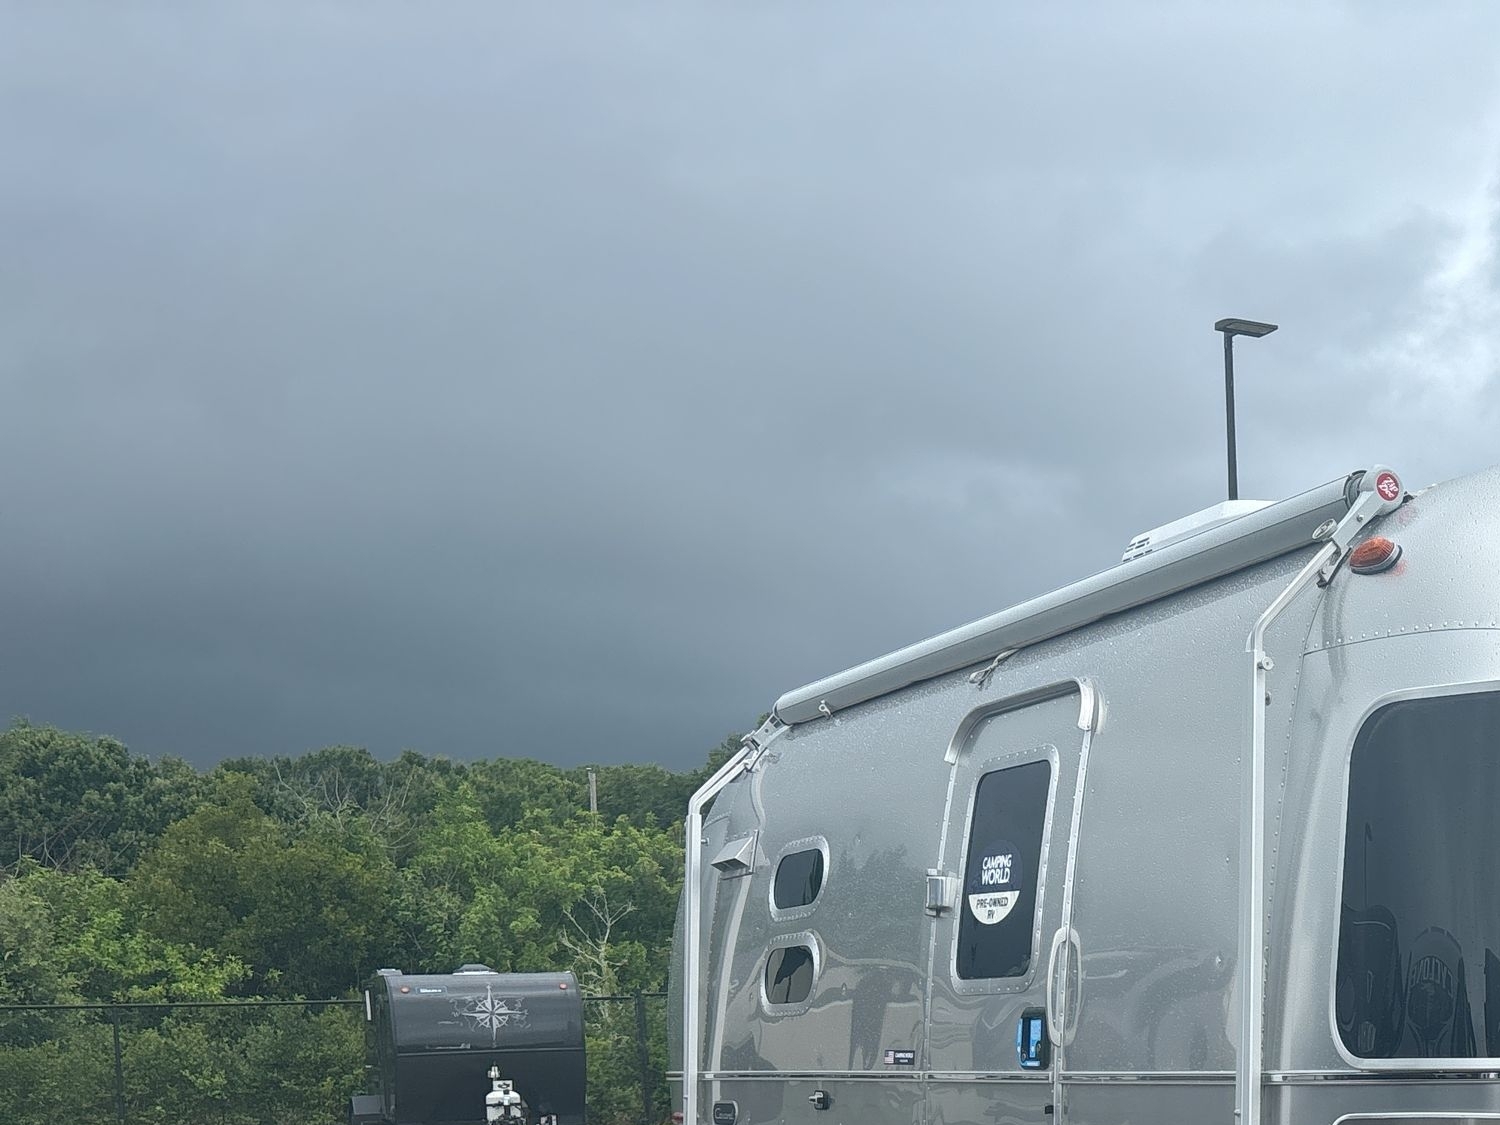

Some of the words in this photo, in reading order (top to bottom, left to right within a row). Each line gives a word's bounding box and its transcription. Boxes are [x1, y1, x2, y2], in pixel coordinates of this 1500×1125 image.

[982, 854, 1013, 870] CAMPING
[981, 868, 1011, 886] WORLD
[976, 896, 1009, 910] PRE-OWNED
